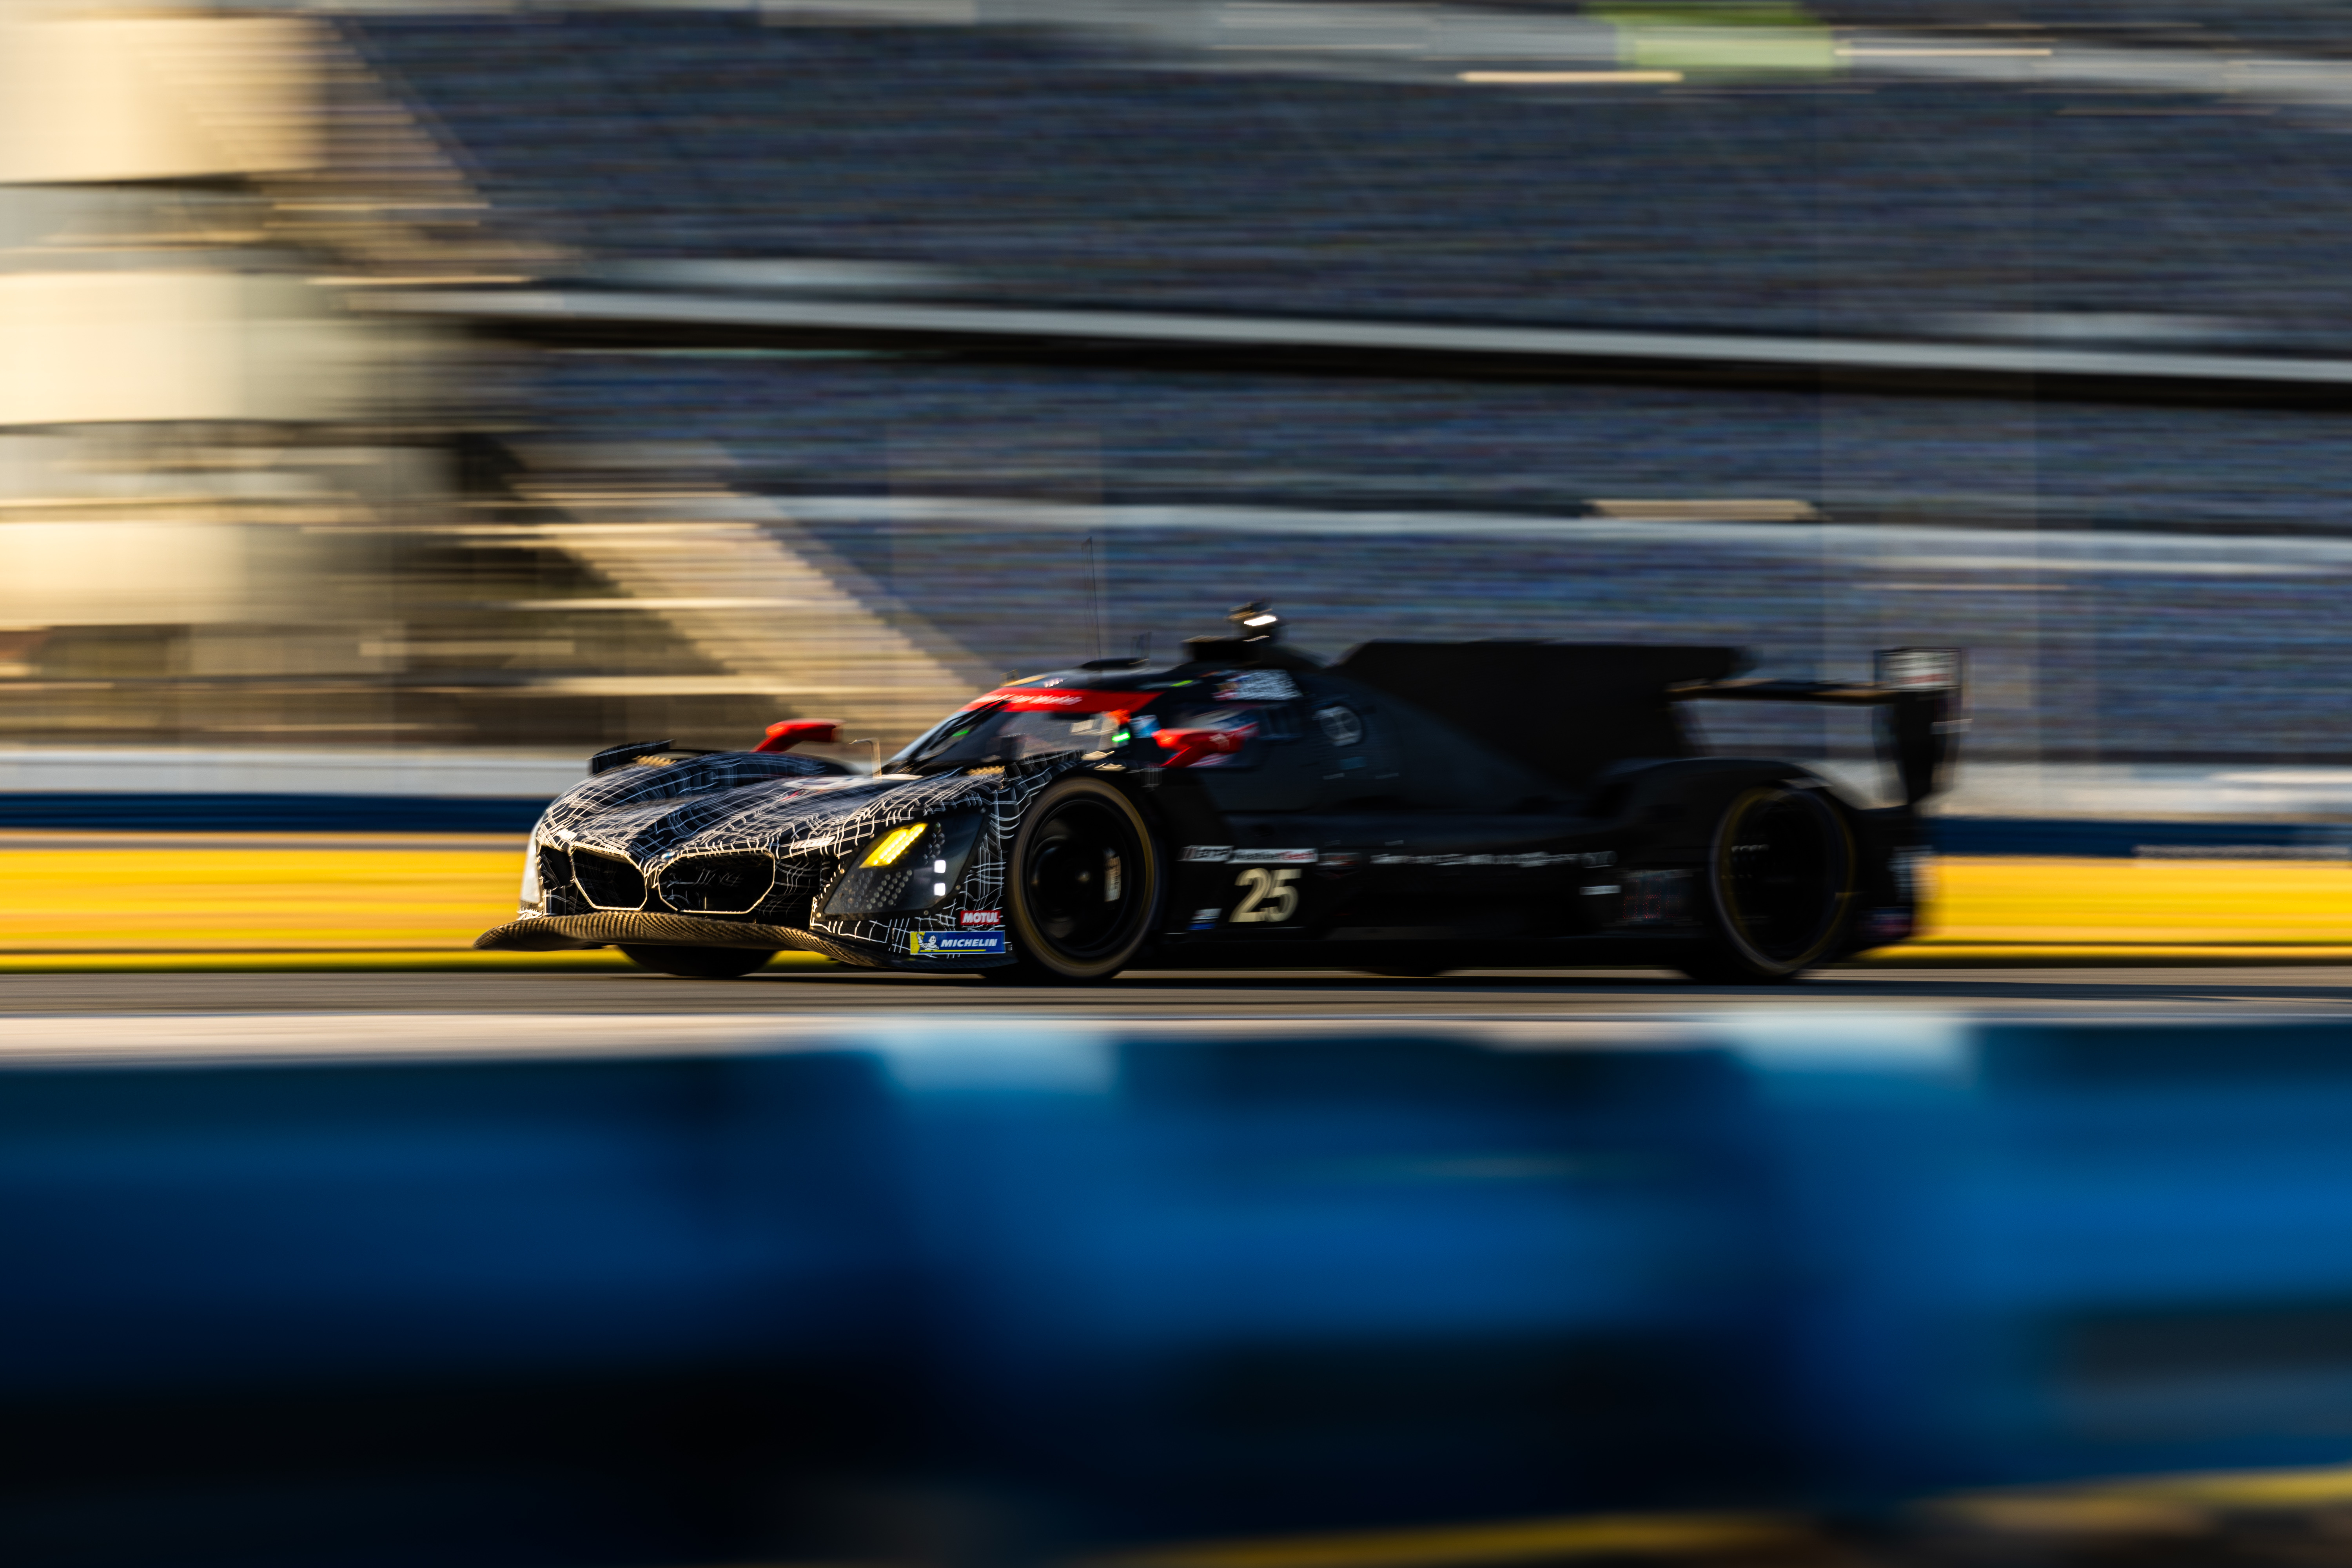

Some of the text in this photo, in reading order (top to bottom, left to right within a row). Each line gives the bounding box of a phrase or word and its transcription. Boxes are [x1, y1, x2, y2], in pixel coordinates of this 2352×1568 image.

[1228, 867, 1302, 922] 25
[962, 912, 999, 923] MOTUL
[940, 938, 998, 947] MICHELIN
